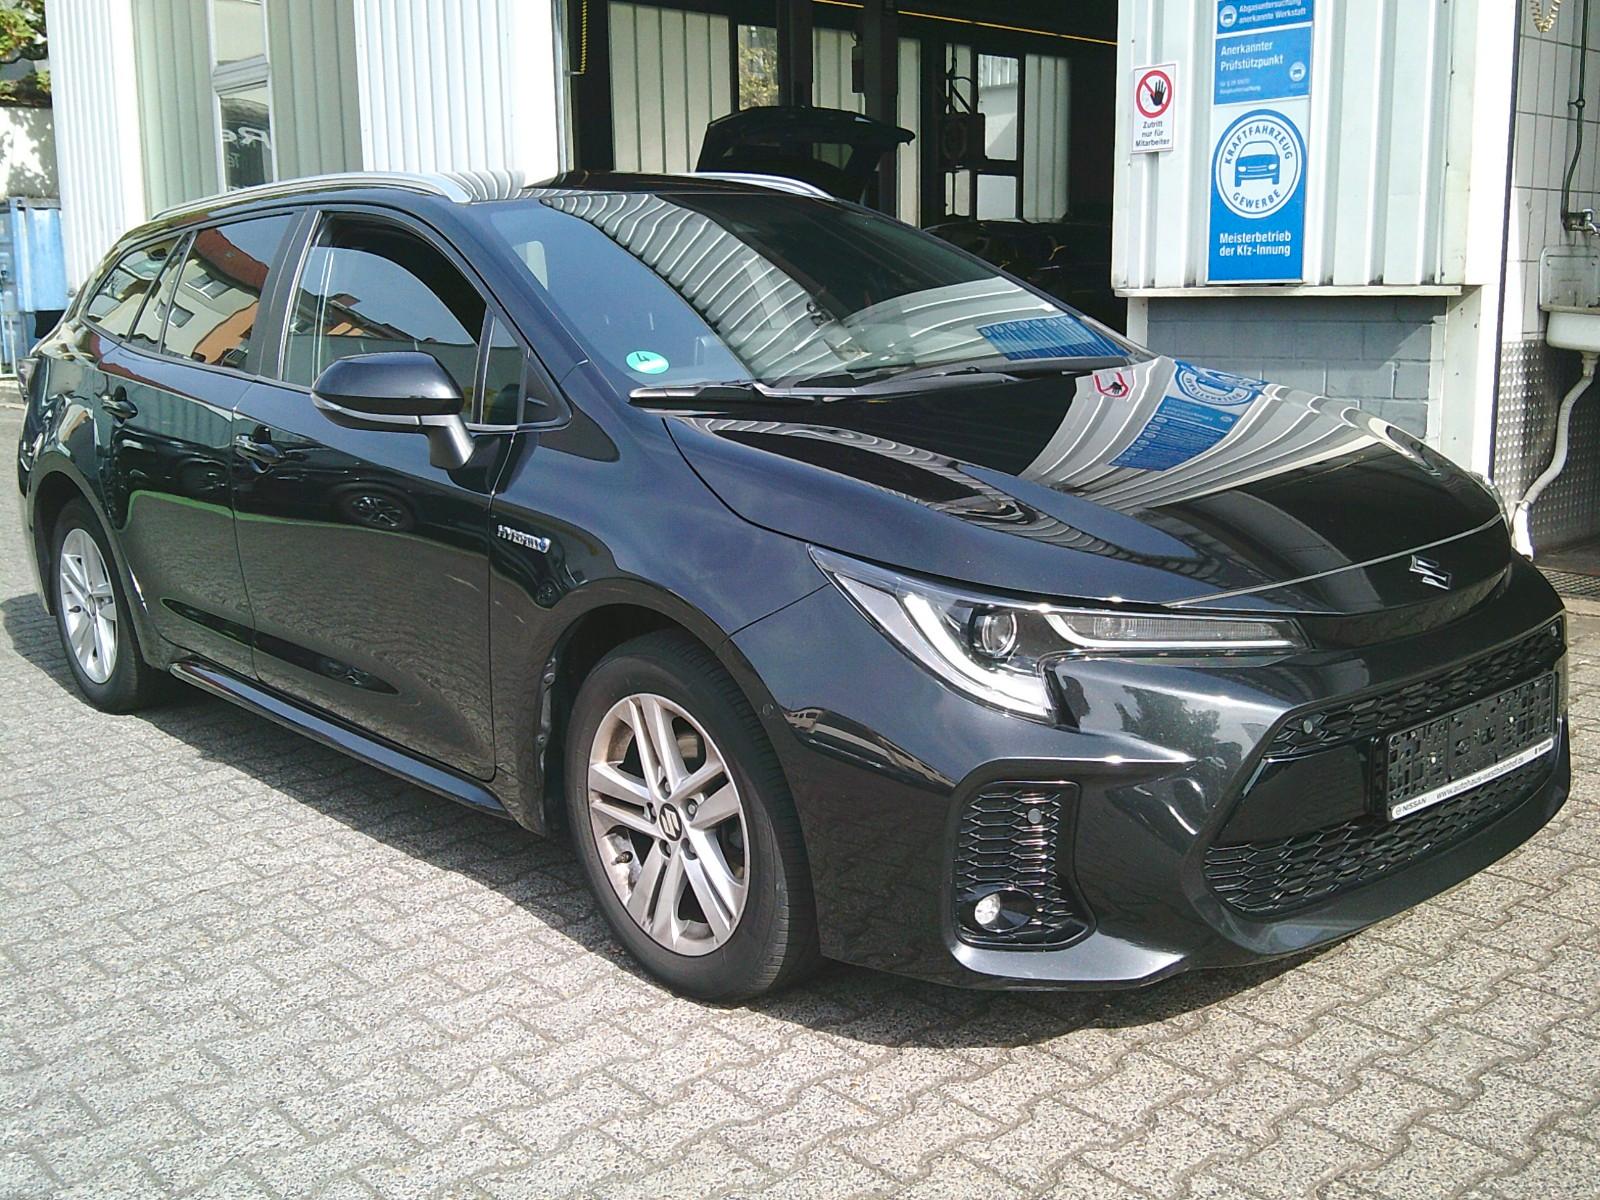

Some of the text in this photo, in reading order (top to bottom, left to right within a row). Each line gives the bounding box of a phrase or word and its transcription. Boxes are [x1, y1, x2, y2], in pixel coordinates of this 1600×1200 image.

[1275, 7, 1307, 18] Werkstatt
[1221, 41, 1273, 57] Anerkannter
[1220, 54, 1284, 72] Prüfstützpunkt
[1142, 120, 1163, 129] Zutritt
[1154, 129, 1164, 137] für
[1135, 138, 1170, 147] Mitarbeiter
[1224, 124, 1293, 165] KRAFTFAHRZEUG
[1232, 188, 1281, 209] GEWERBE
[1219, 230, 1292, 244] Meisterbetrieb
[1219, 243, 1291, 257] der Kfz-Innung
[635, 352, 651, 363] 4
[1402, 797, 1427, 813] NISSAN
